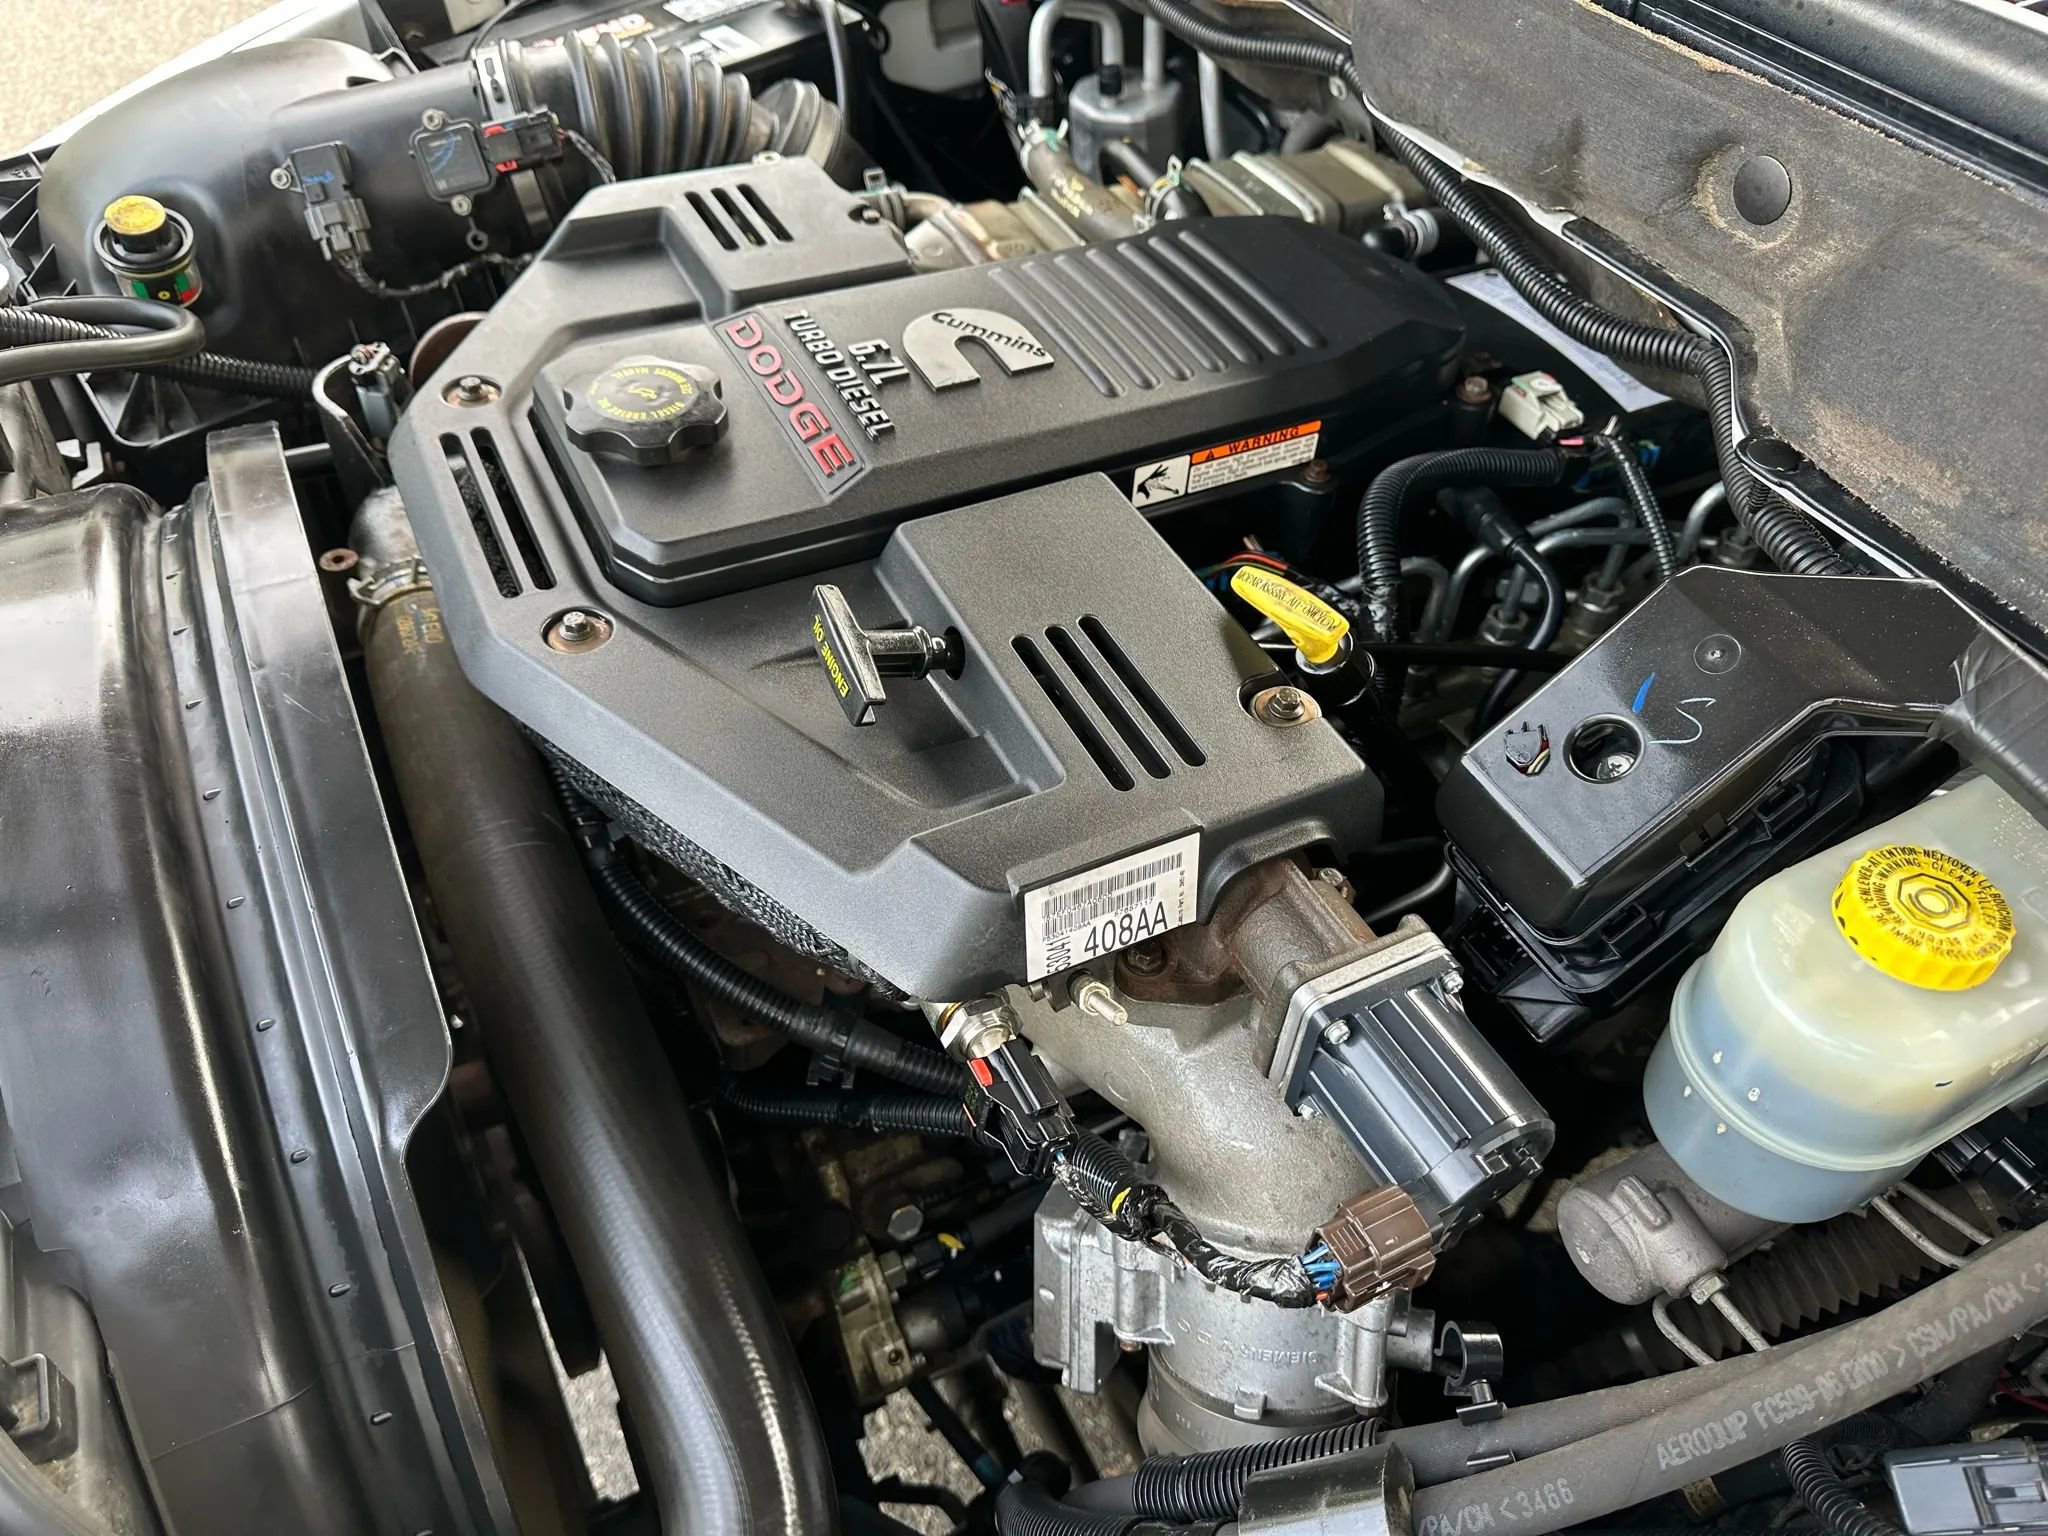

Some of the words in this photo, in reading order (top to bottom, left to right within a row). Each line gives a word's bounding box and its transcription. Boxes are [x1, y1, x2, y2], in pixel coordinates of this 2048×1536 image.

[931, 311, 1049, 358] Cummins
[784, 308, 848, 368] TURBO
[827, 362, 896, 443] DIESEL
[848, 338, 910, 388] 6.7L
[726, 314, 857, 478] DODGE
[1228, 426, 1299, 454] WARNING
[821, 641, 850, 698] ENGINE
[1931, 861, 1974, 887] CLEAN
[1084, 901, 1168, 957] 408AA
[1240, 1343, 1319, 1366] SIEMENS
[1656, 1409, 1748, 1471] AEROQUIP
